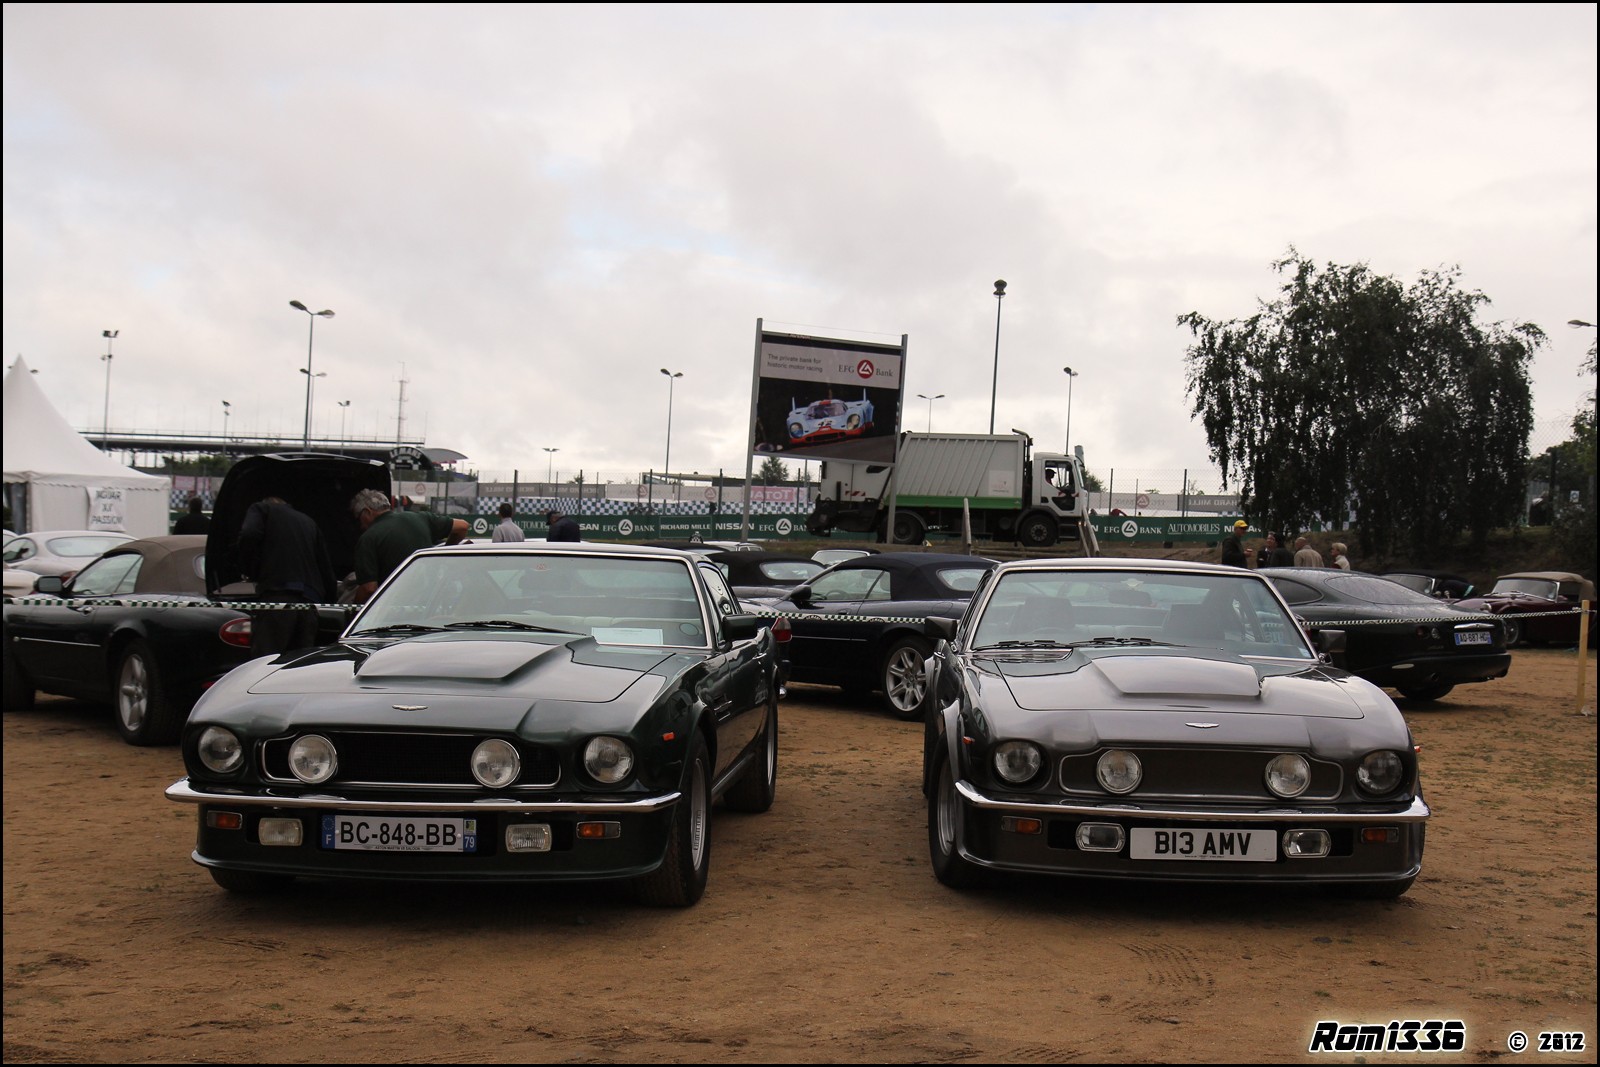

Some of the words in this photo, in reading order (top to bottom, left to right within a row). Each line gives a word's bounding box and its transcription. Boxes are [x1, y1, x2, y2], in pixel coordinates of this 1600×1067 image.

[779, 355, 798, 363] private
[806, 365, 823, 373] racing
[838, 364, 854, 374] EFG
[876, 368, 893, 377] Bank
[1168, 524, 1220, 532] AUTOMOBILES
[326, 834, 332, 844] F
[340, 822, 456, 846] BC-848-BB
[465, 836, 475, 848] 79
[1202, 832, 1251, 855] AMV
